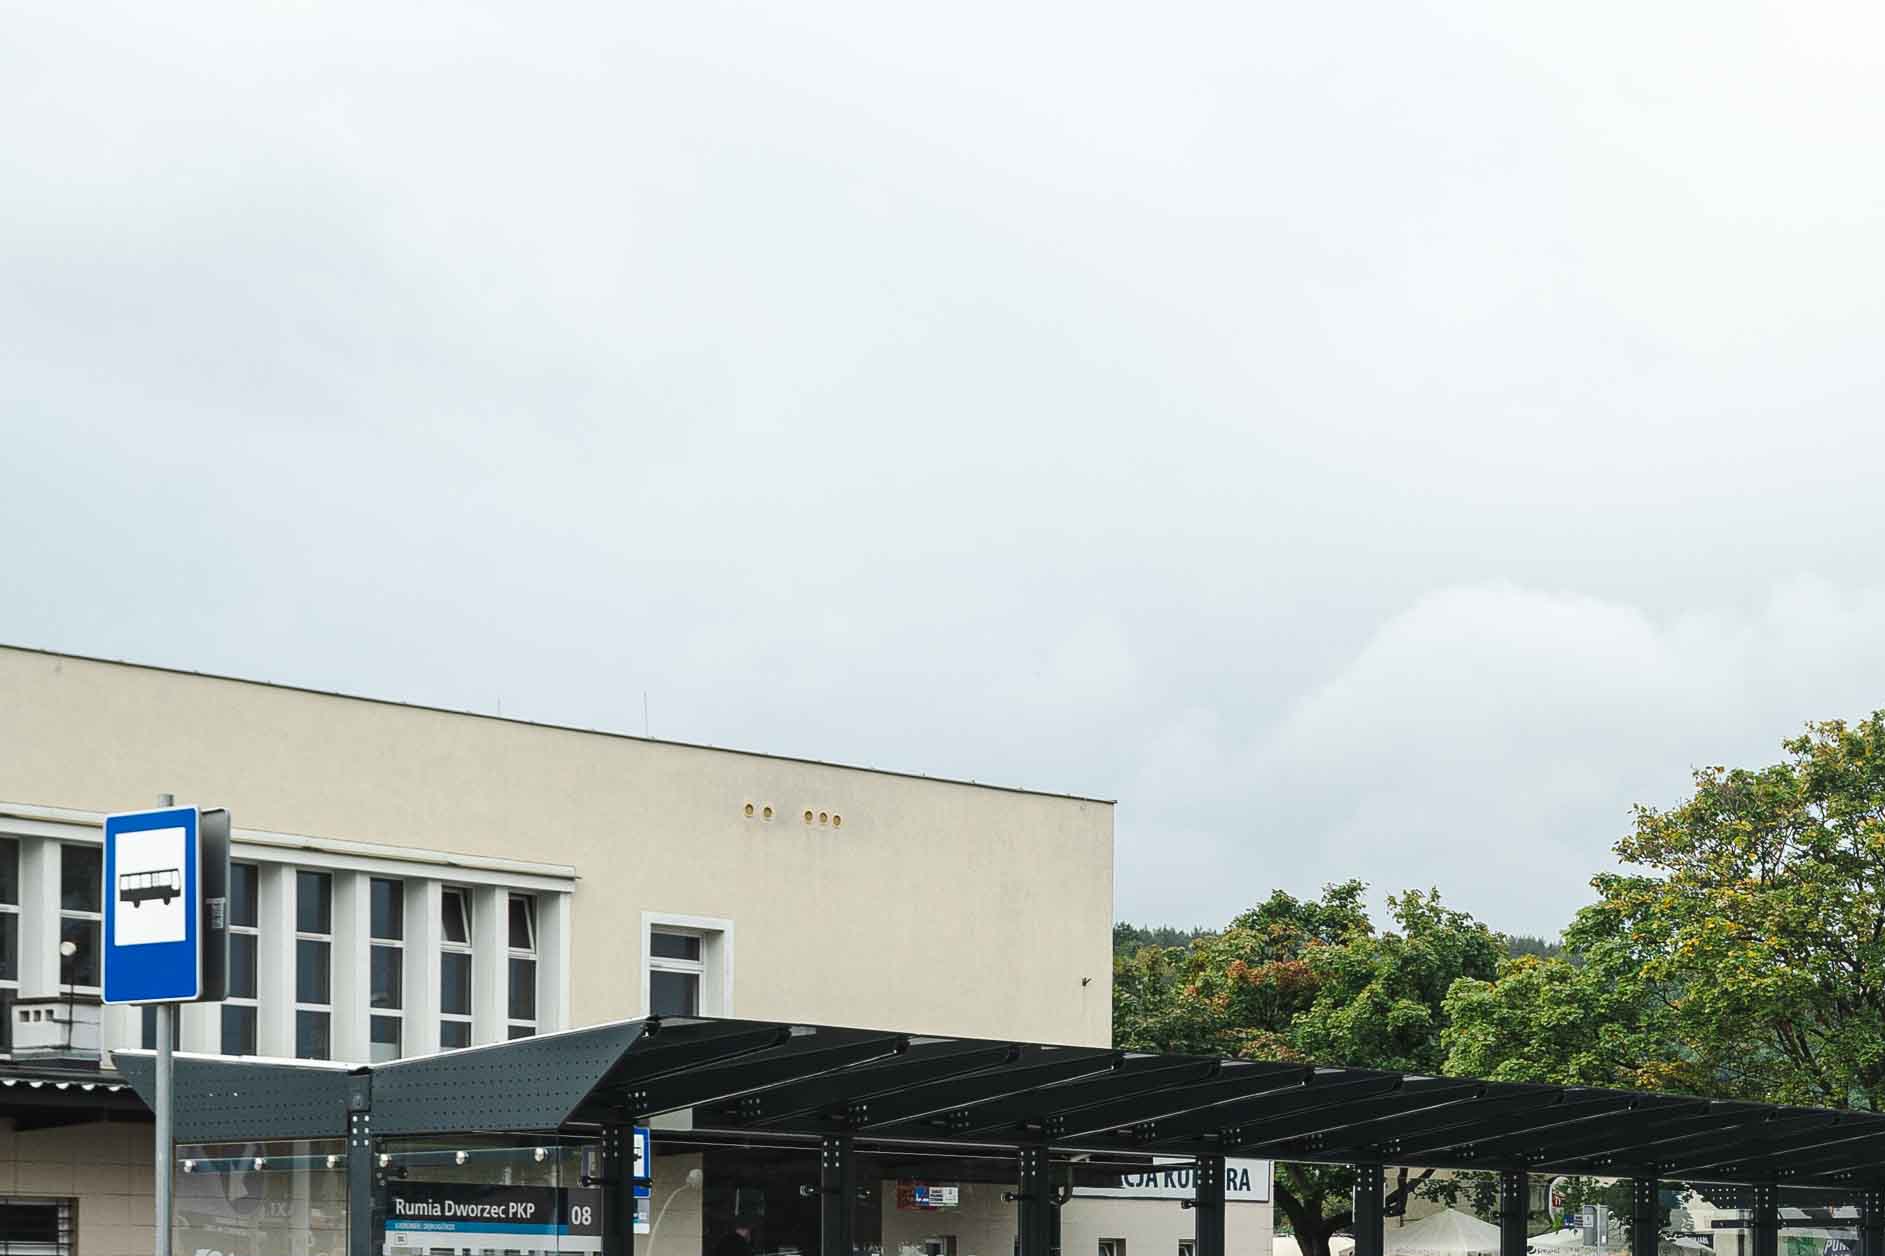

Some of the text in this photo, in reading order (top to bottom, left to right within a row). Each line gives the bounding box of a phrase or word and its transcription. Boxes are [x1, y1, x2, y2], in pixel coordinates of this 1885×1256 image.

[395, 1198, 536, 1219] Rumia Dworzec PKP
[571, 1205, 592, 1225] 08
